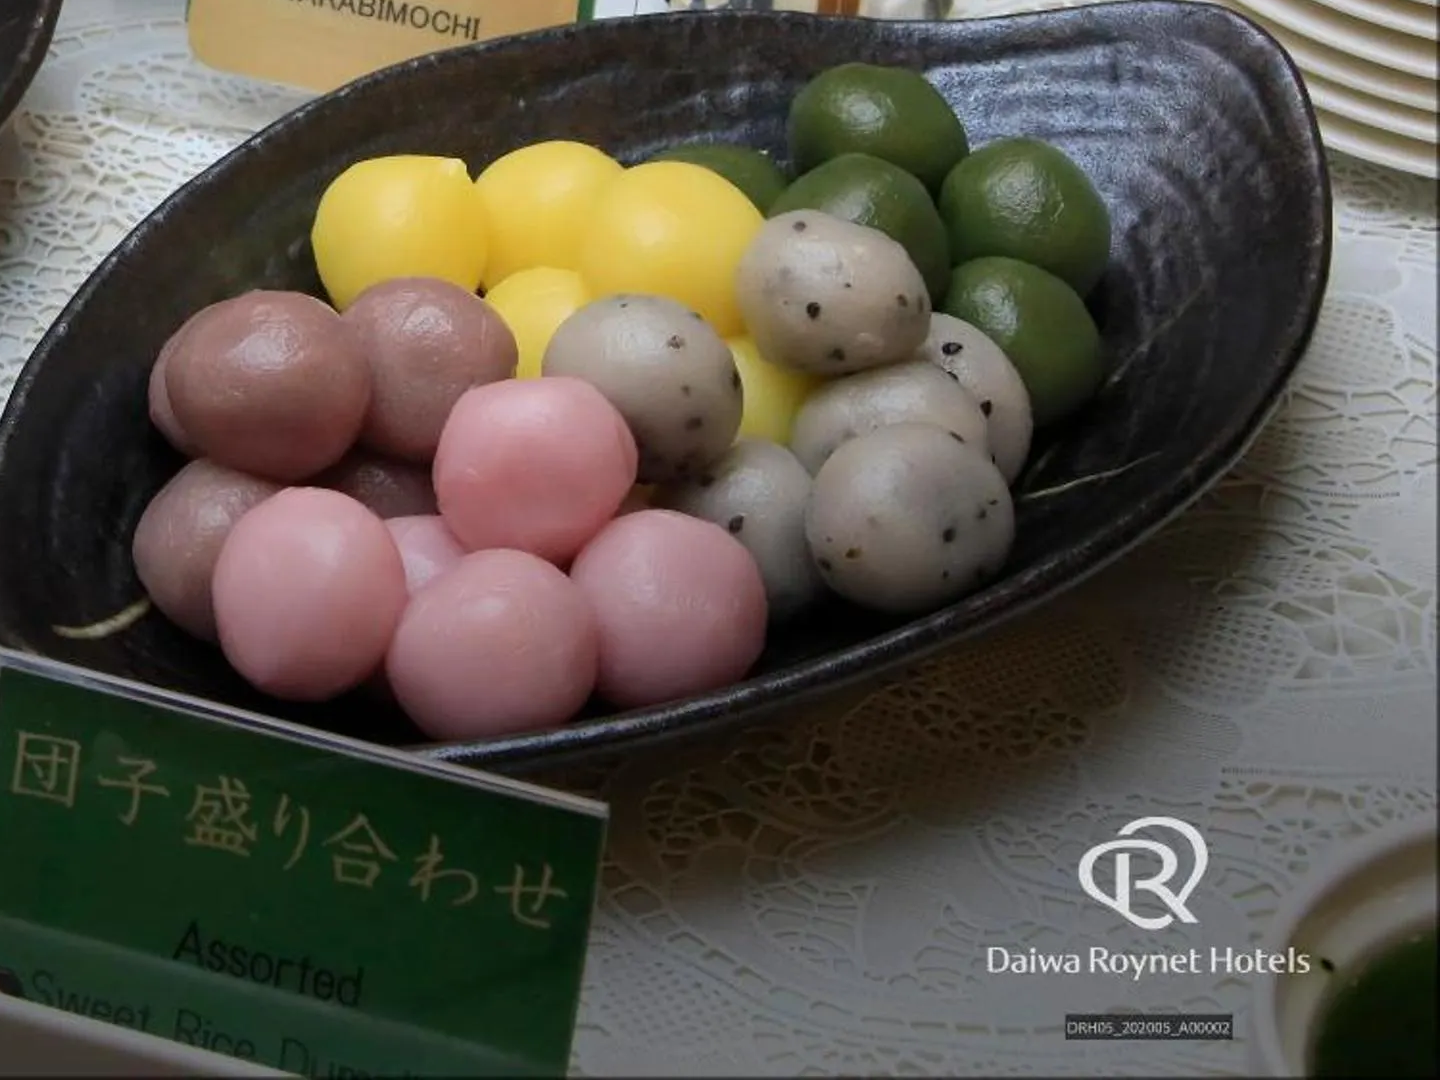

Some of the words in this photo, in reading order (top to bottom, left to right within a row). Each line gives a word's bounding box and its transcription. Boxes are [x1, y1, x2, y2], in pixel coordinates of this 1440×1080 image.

[12, 729, 566, 929] 団子盛り合わせ
[173, 920, 363, 1008] Assorted
